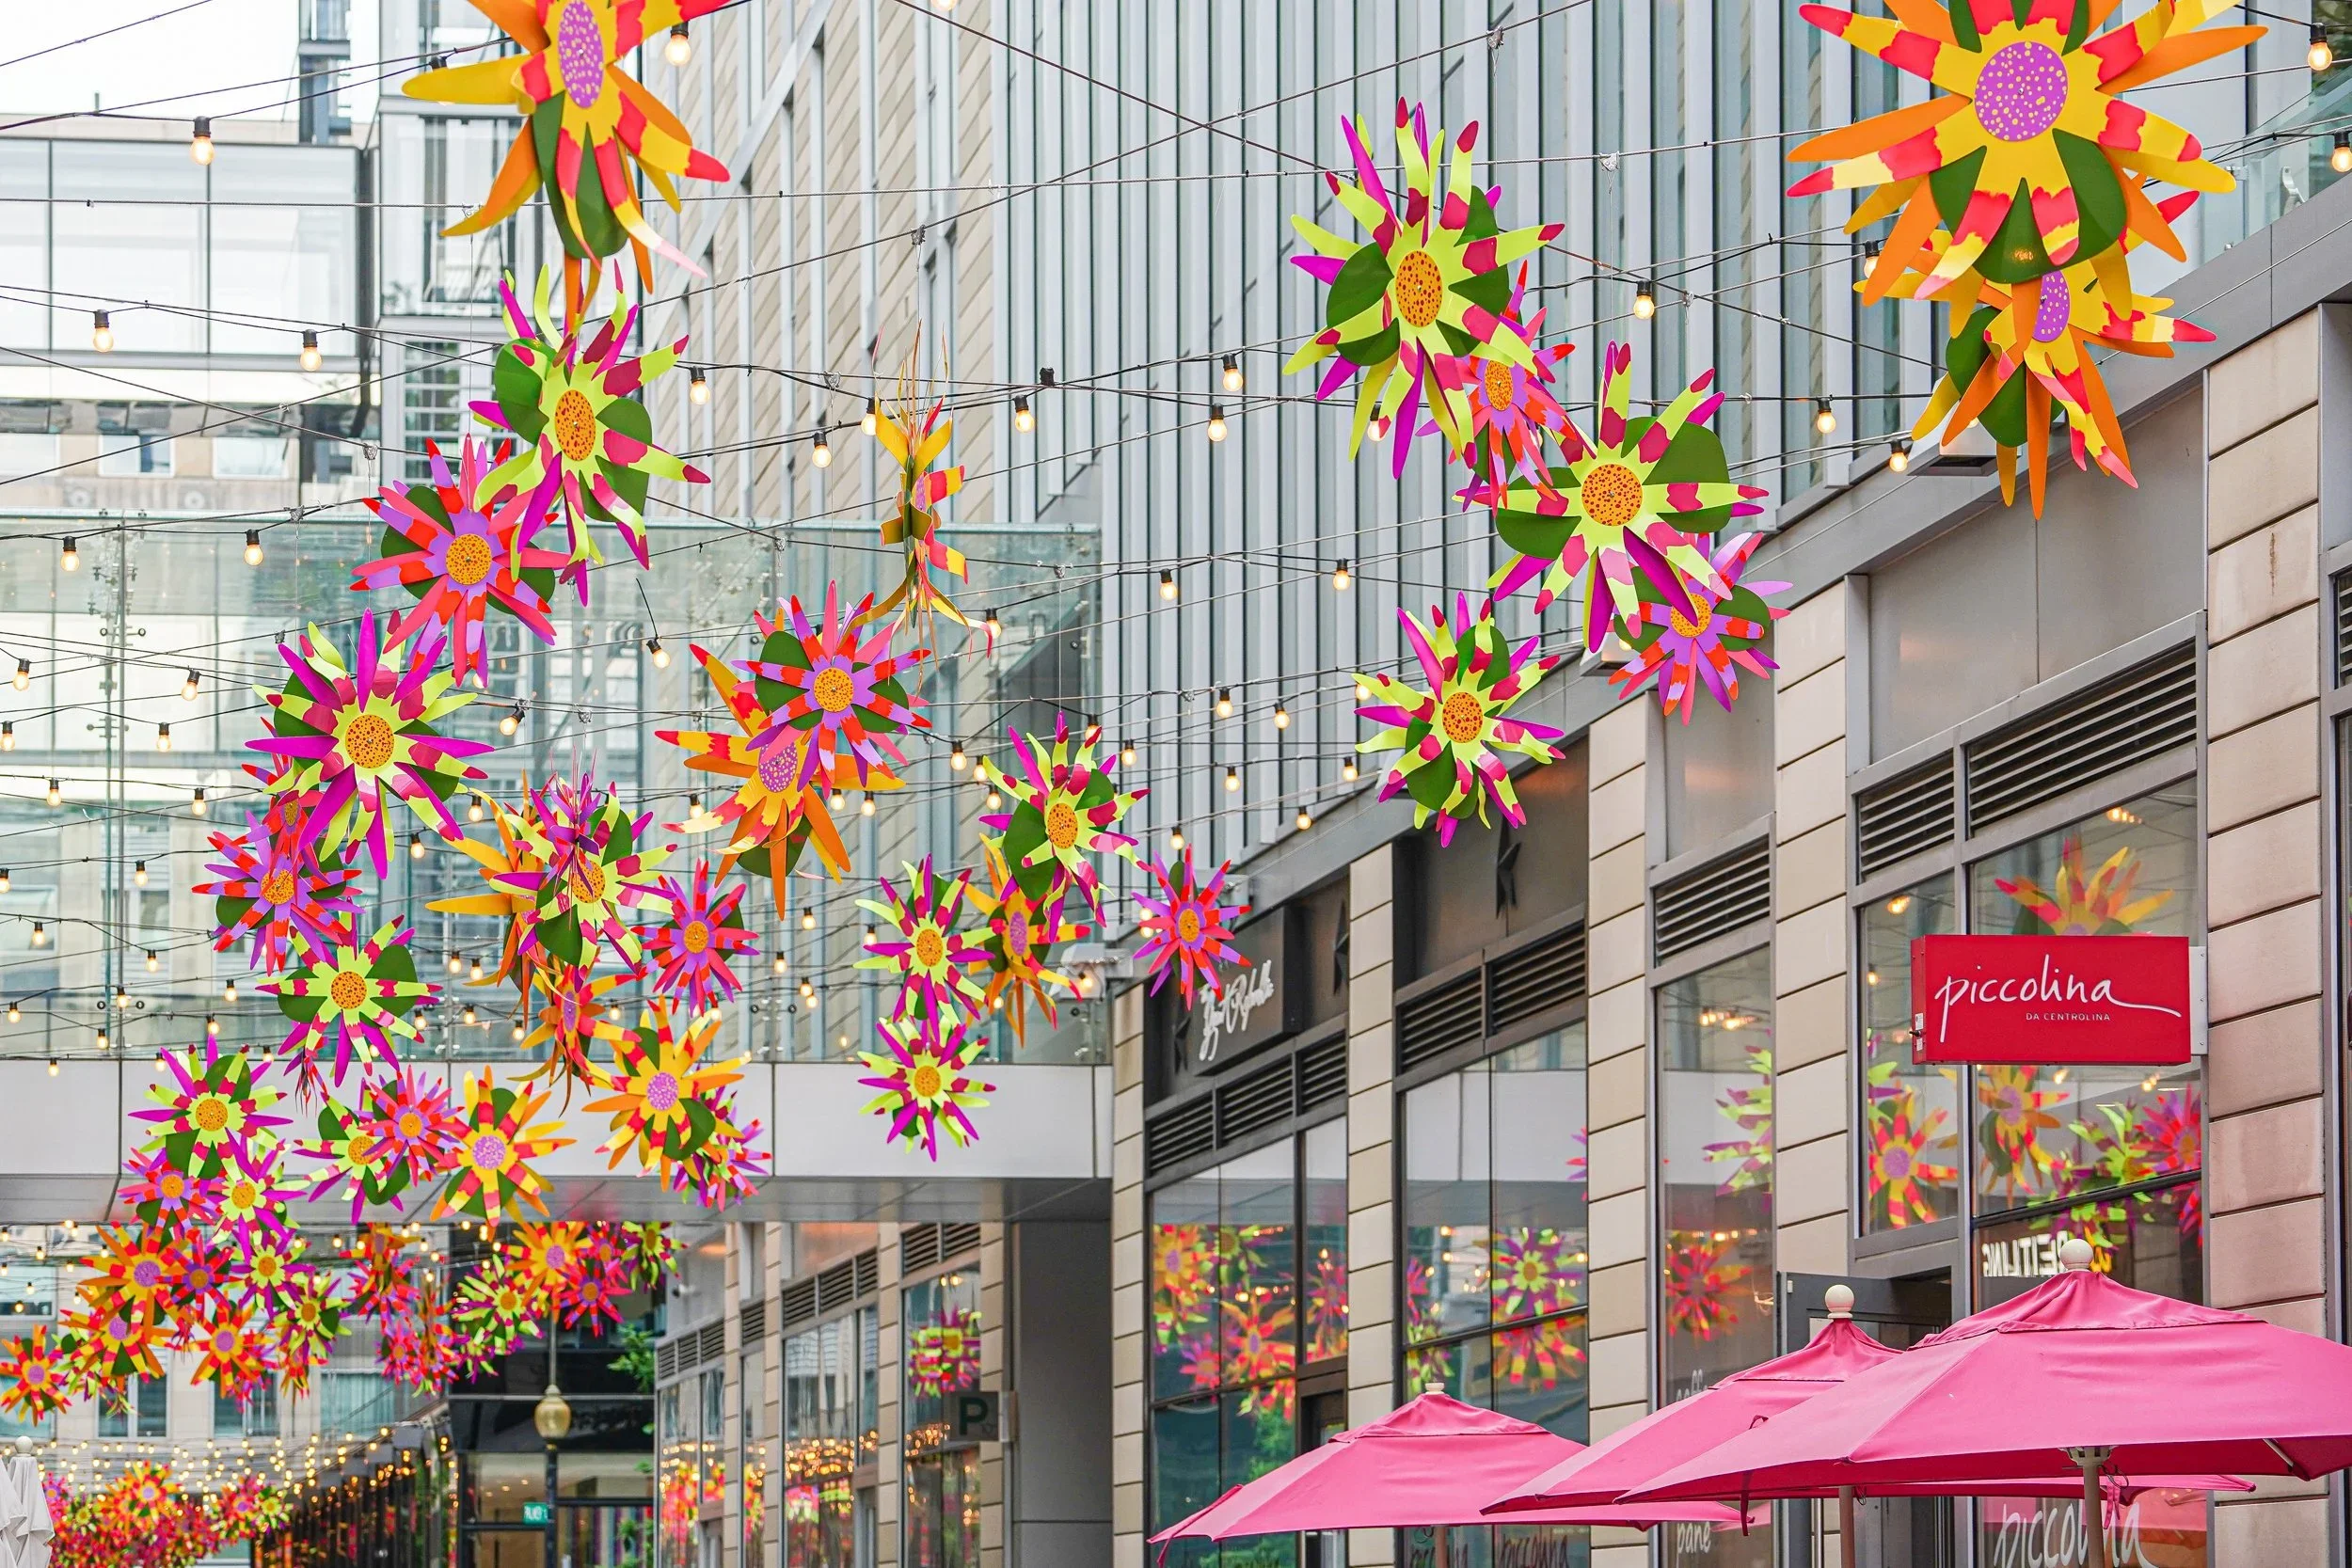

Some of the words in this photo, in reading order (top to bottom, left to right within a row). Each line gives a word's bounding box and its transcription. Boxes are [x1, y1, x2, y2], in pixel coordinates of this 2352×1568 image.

[1934, 954, 2182, 1042] piccolina
[2026, 1012, 2040, 1021] DA
[2043, 1012, 2110, 1022] CENTROLINA
[959, 1397, 988, 1435] P
[1676, 1521, 1711, 1568] pane
